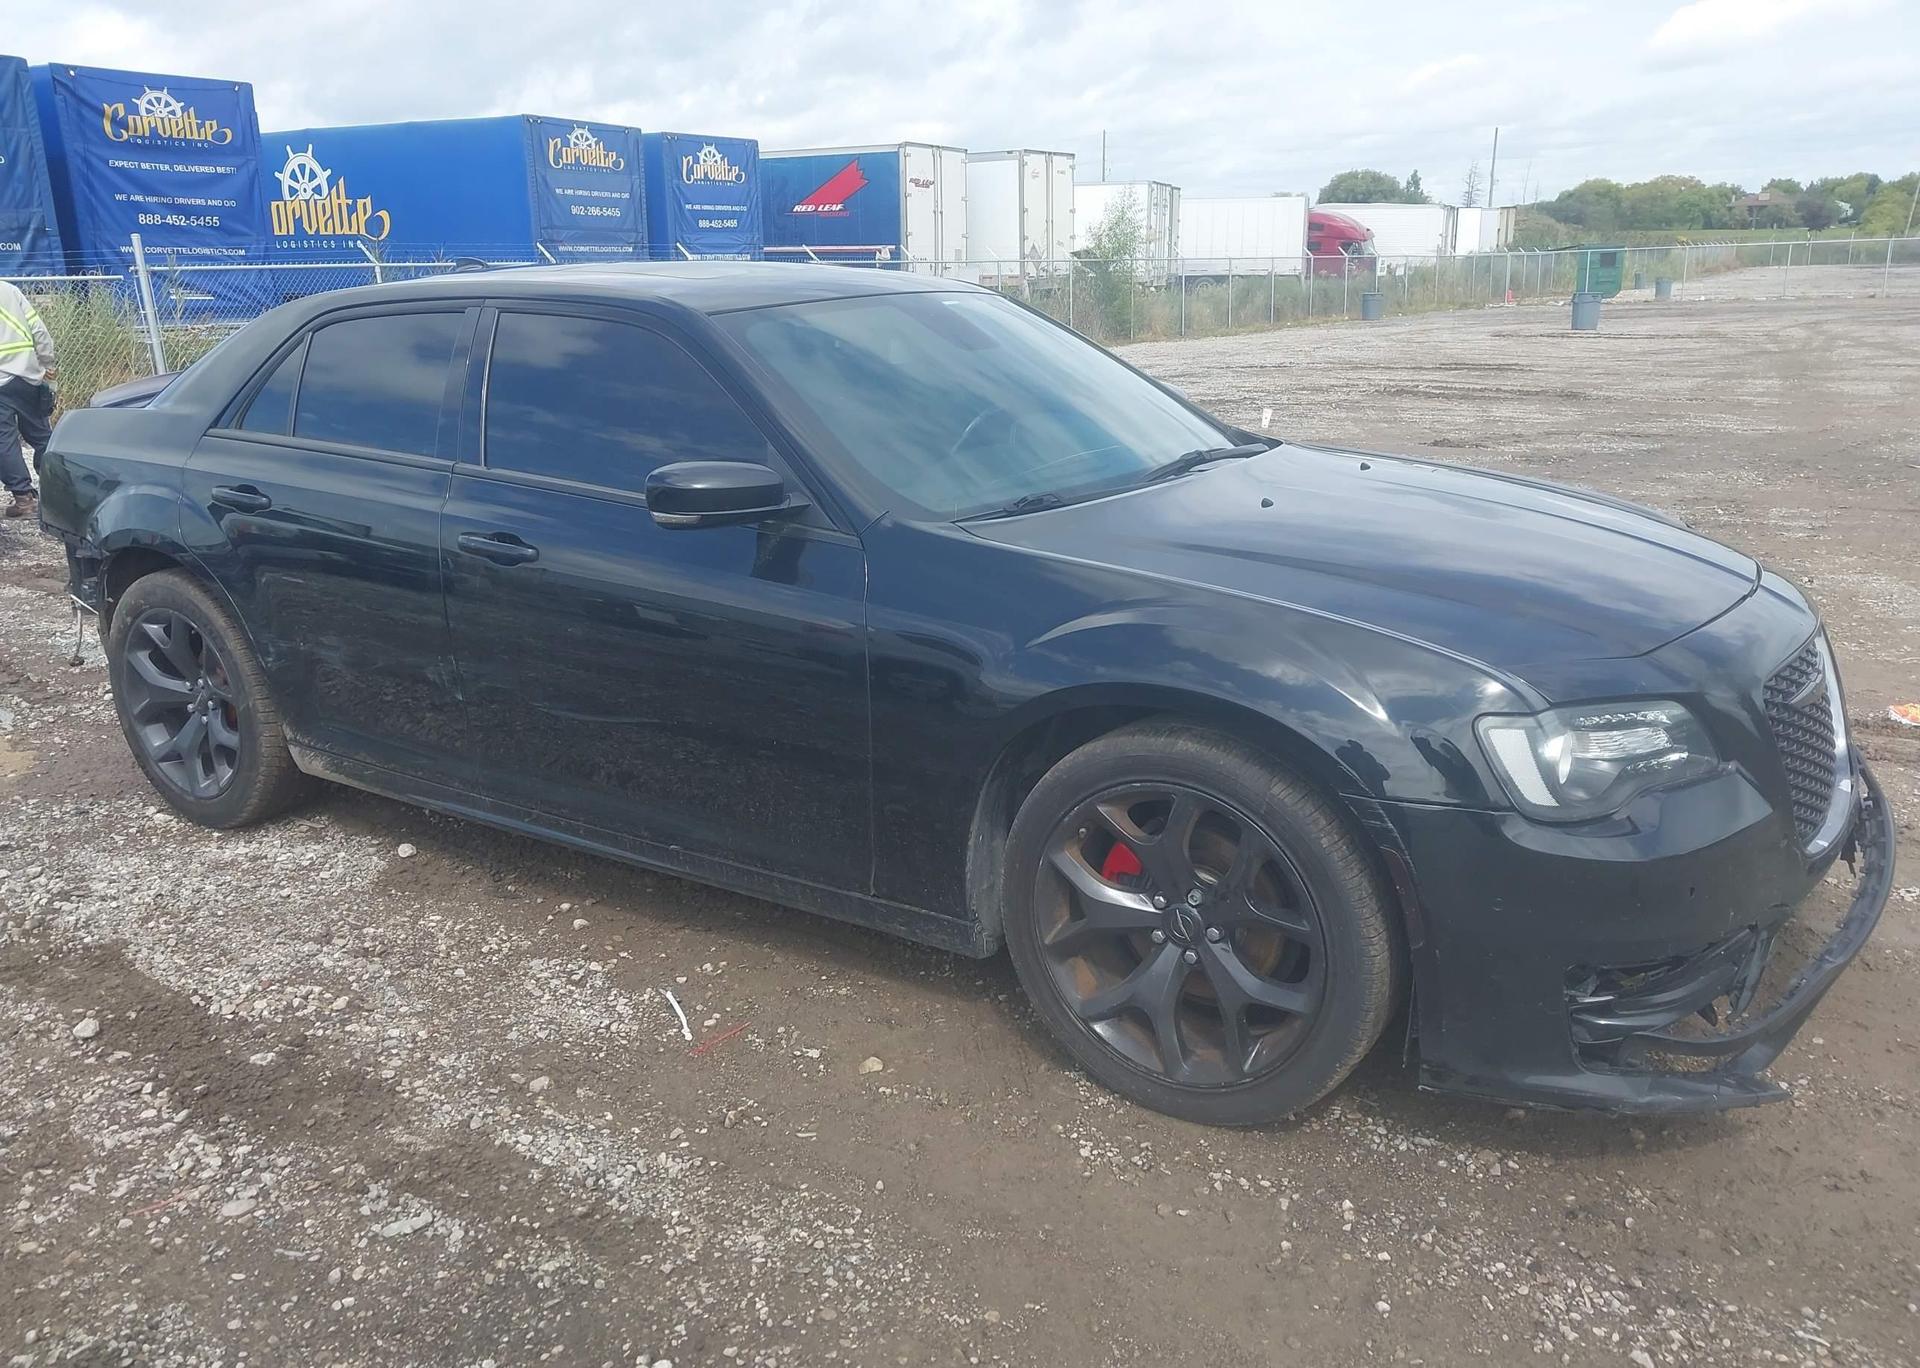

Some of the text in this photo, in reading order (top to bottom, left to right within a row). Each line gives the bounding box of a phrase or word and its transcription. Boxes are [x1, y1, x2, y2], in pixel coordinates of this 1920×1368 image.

[103, 103, 232, 145] Corvette
[130, 138, 186, 147] LOGISTICS
[548, 137, 624, 171] Corvette
[108, 159, 237, 174] EXPECT BETTER, DELIVERED BEST!
[682, 156, 745, 184] Corvette
[114, 193, 128, 201] WE
[130, 194, 144, 202] ARE
[145, 195, 173, 204] HIRING
[174, 197, 206, 206] DRIVERS
[570, 205, 621, 217] 902-266-5455
[792, 203, 845, 212] RED LEAF
[138, 213, 220, 227] 888-452-5455
[275, 240, 336, 249] LOGISTICS
